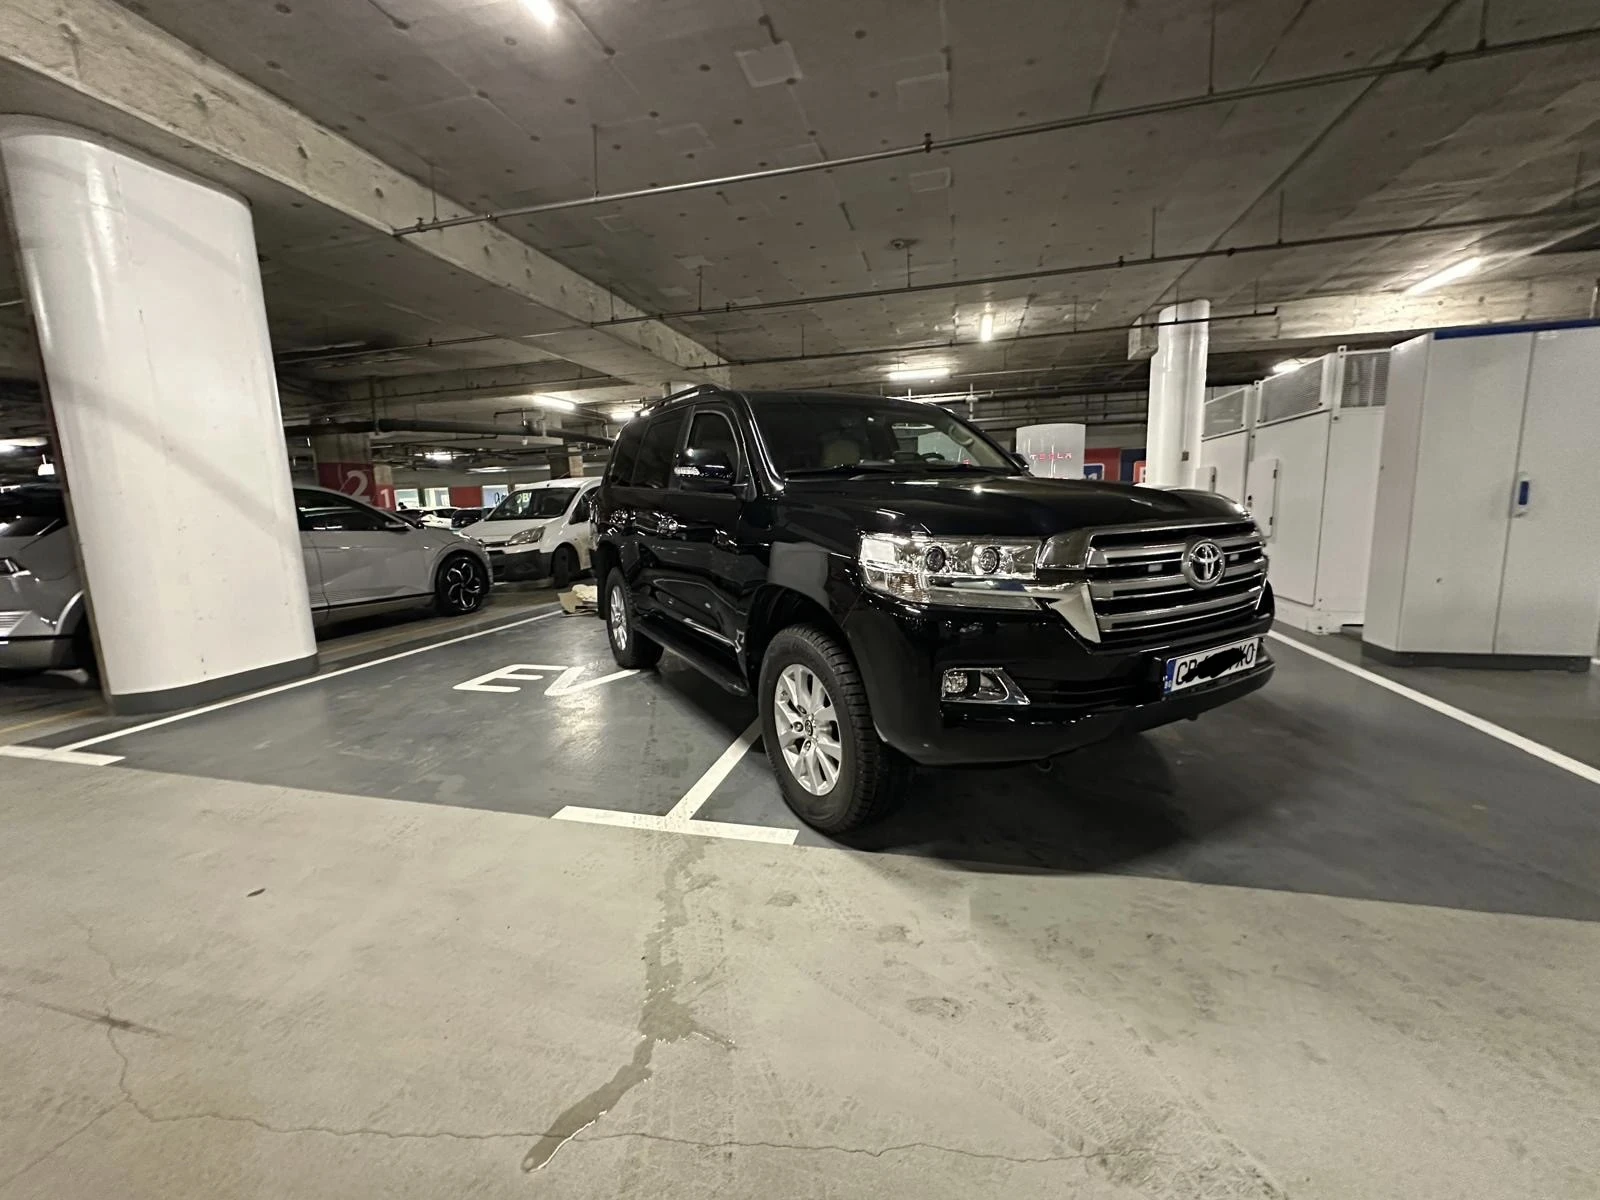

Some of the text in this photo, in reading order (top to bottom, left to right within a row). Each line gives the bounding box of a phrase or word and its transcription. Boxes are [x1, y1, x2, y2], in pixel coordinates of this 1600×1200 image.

[347, 470, 371, 502] 2
[380, 489, 391, 508] 1
[452, 663, 641, 697] EV
